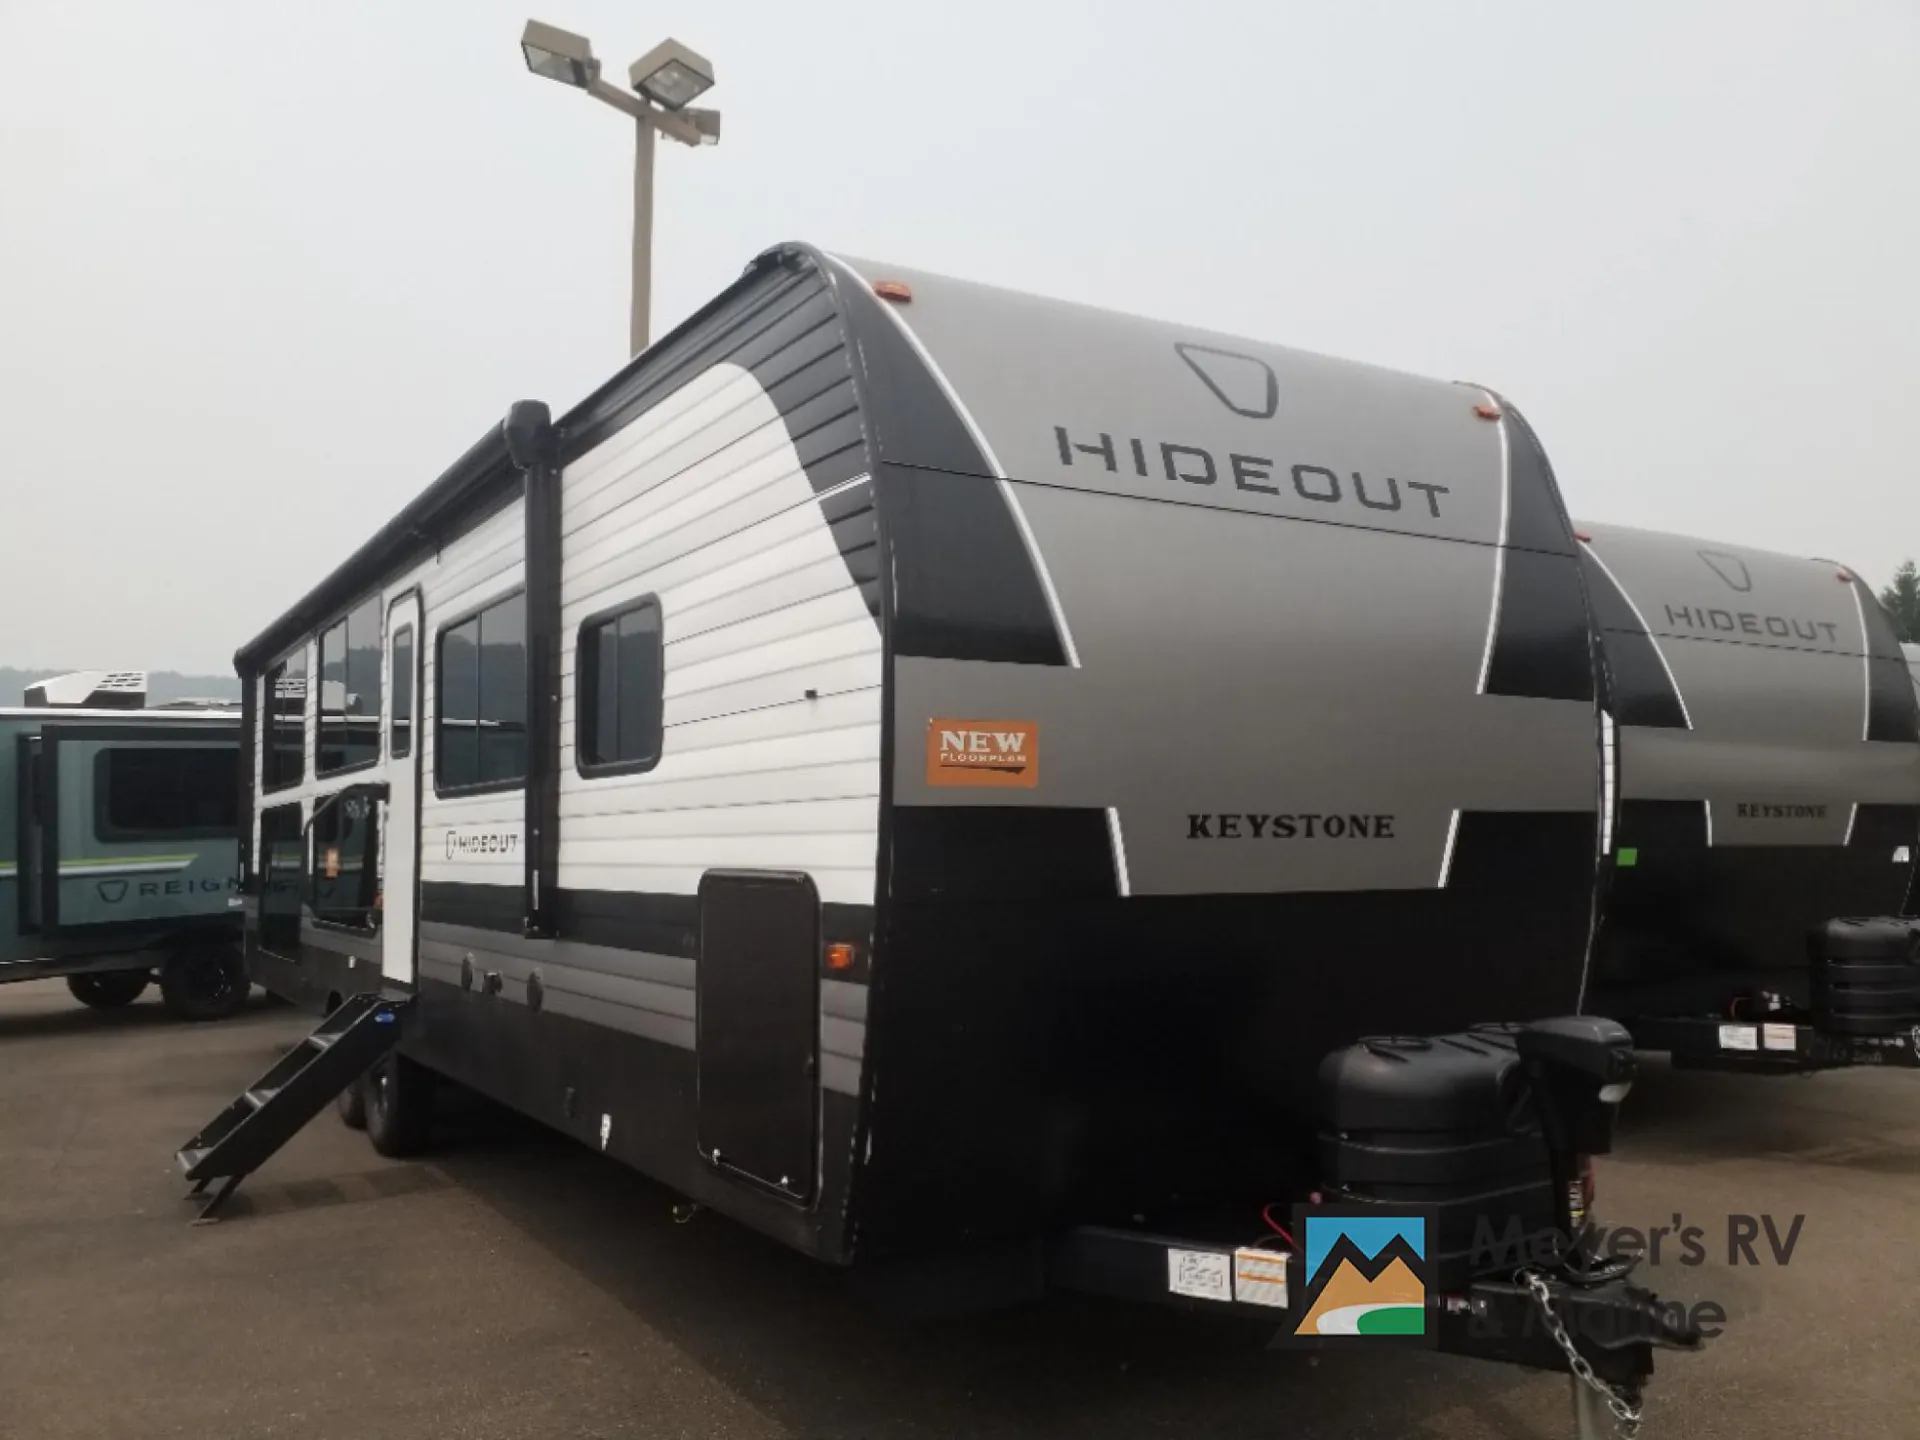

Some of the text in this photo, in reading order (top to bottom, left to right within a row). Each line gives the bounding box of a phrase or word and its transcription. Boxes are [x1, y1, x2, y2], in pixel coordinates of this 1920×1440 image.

[1054, 425, 1450, 518] HIDEOUT
[1664, 604, 1837, 642] HIDEOUT
[940, 730, 1026, 753] NEW
[940, 753, 1026, 762] FLOORPLAN
[1737, 804, 1826, 819] KEYSTONE
[1187, 813, 1395, 839] KEYSTONE
[459, 834, 518, 853] HIDEOUT
